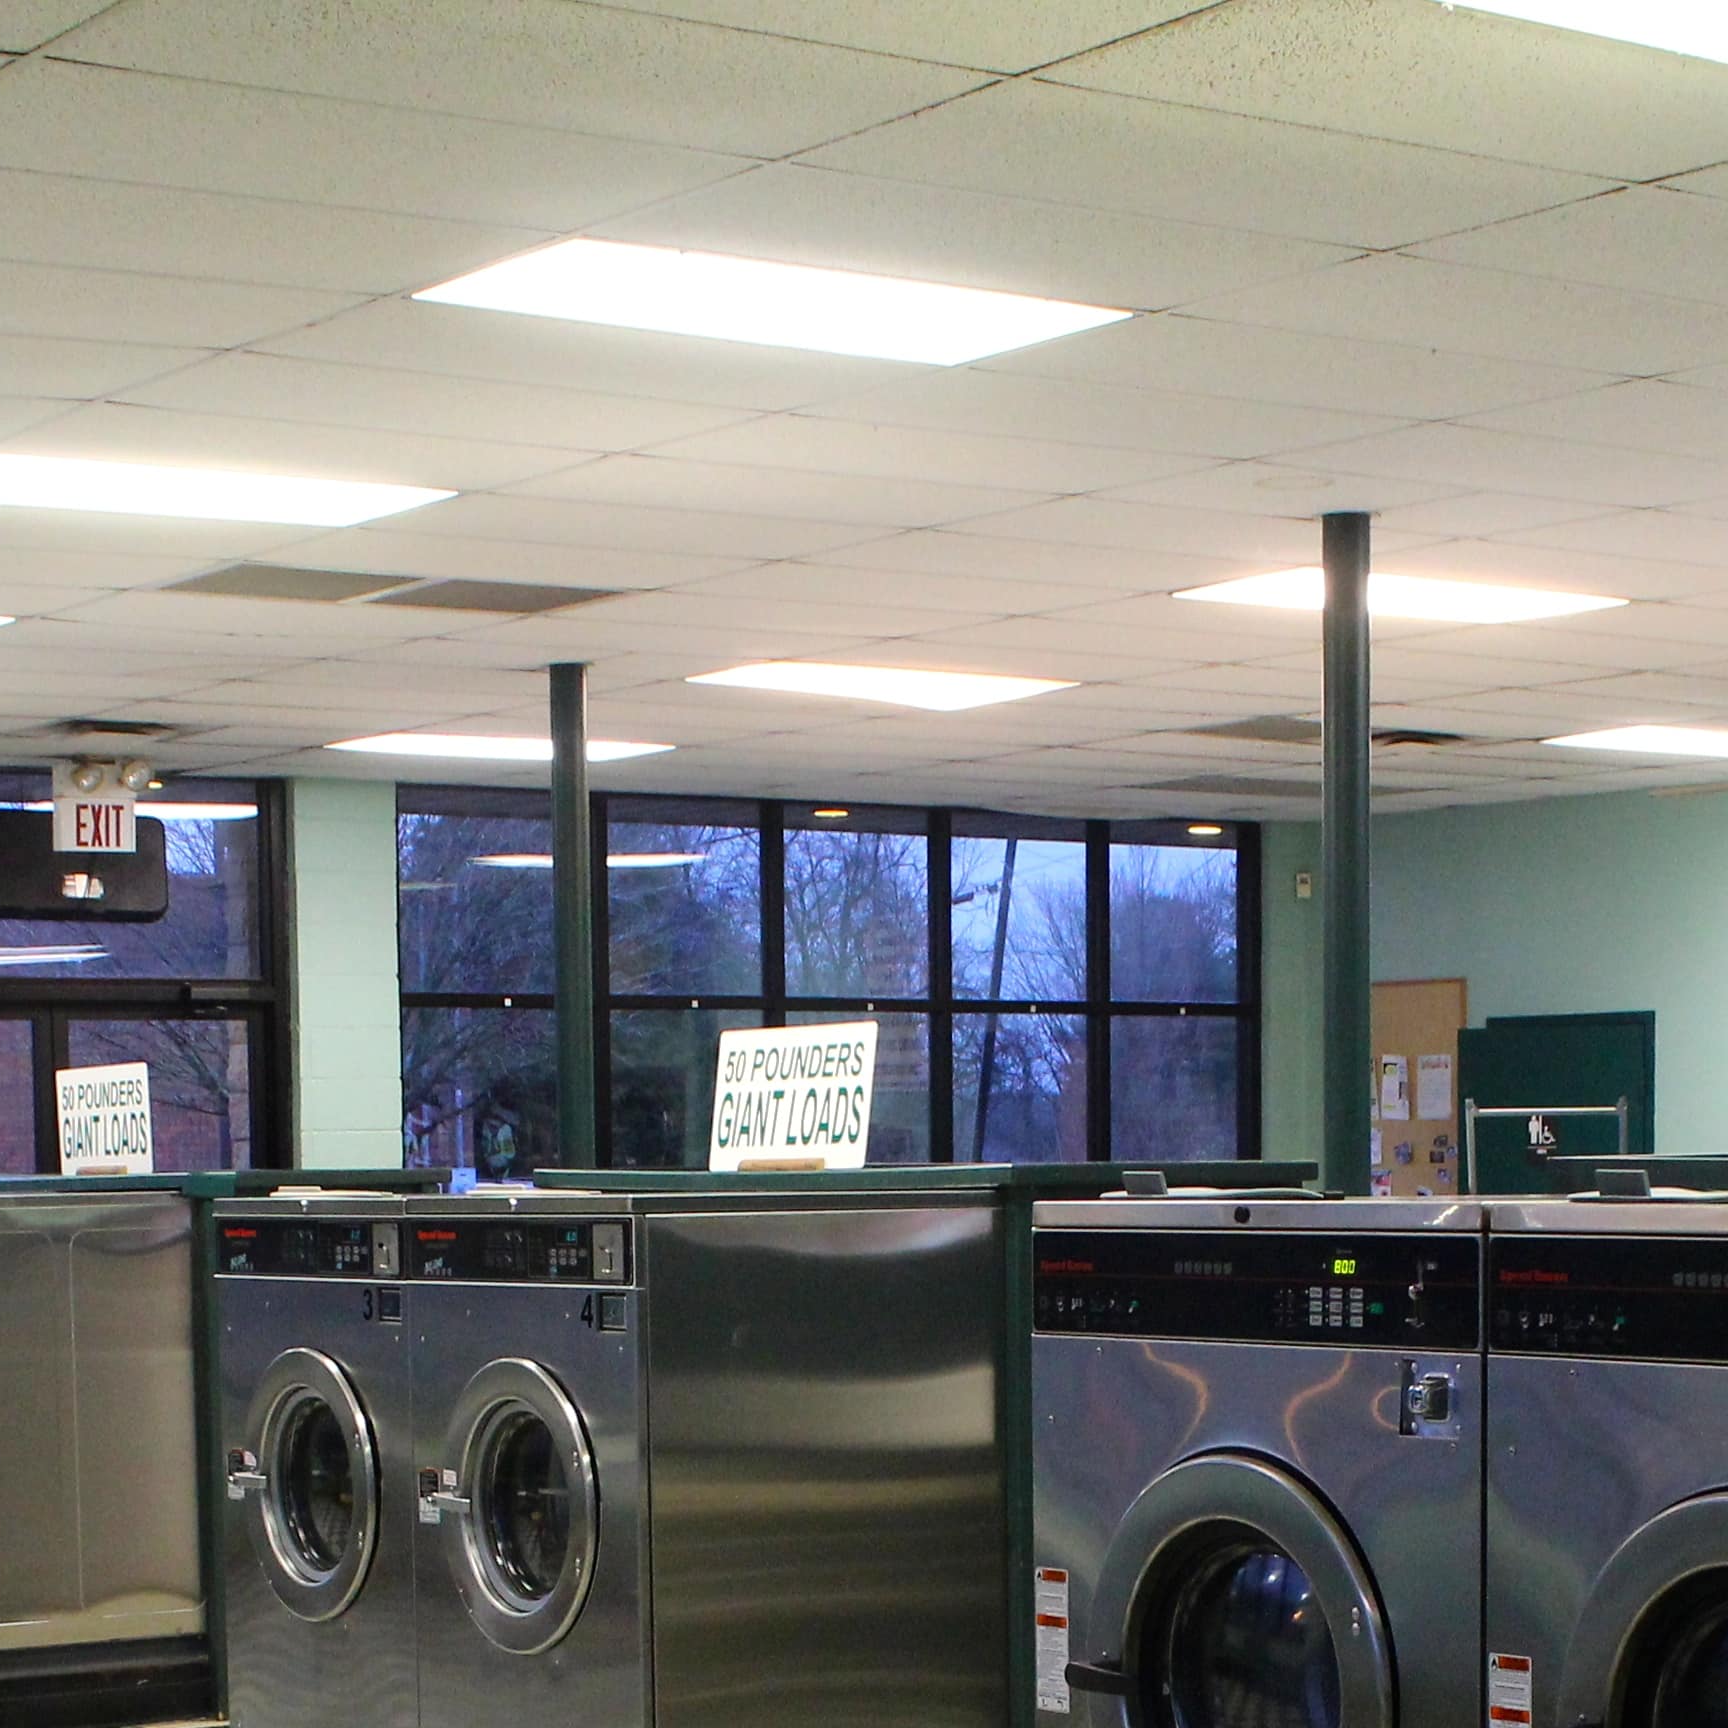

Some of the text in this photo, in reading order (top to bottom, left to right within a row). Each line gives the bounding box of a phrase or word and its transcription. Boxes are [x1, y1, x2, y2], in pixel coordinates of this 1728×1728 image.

[76, 804, 124, 847] EXIT
[725, 1041, 865, 1083] 50 POUNDERS
[62, 1079, 143, 1111] 50 POUNDERS
[63, 1111, 148, 1159] GIANT LOADS
[717, 1085, 864, 1148] GIANT LOADS
[1333, 1259, 1357, 1275] 800
[362, 1288, 373, 1321] 3
[580, 1293, 594, 1329] 4
